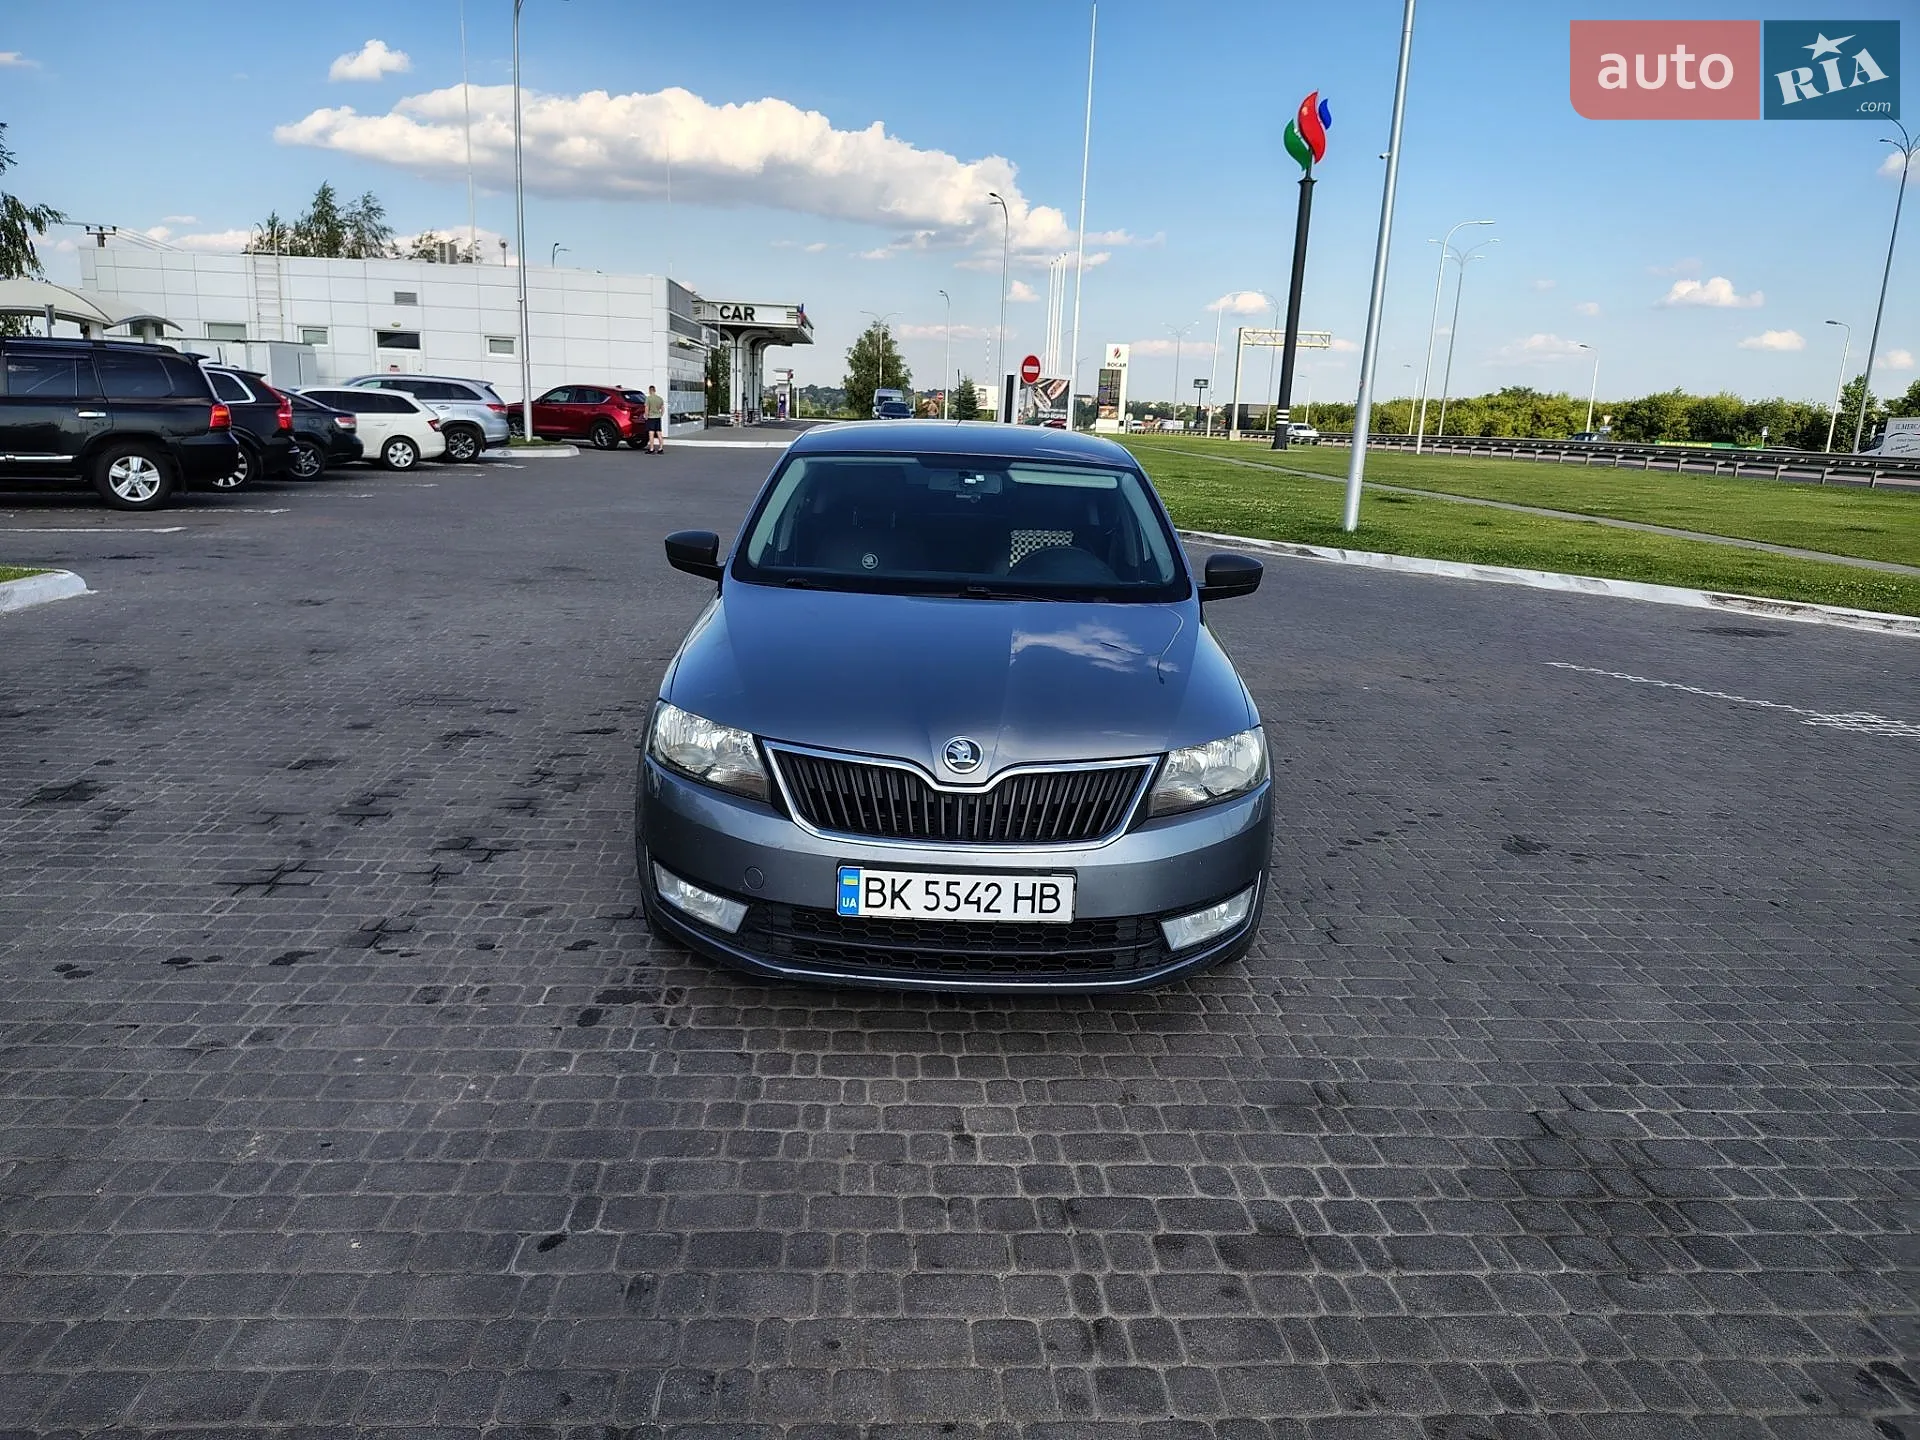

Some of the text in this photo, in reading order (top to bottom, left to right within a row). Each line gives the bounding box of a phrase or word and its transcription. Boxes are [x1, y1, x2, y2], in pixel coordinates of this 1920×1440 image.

[842, 897, 857, 908] UA
[865, 876, 1061, 914] BK 5542 HB
